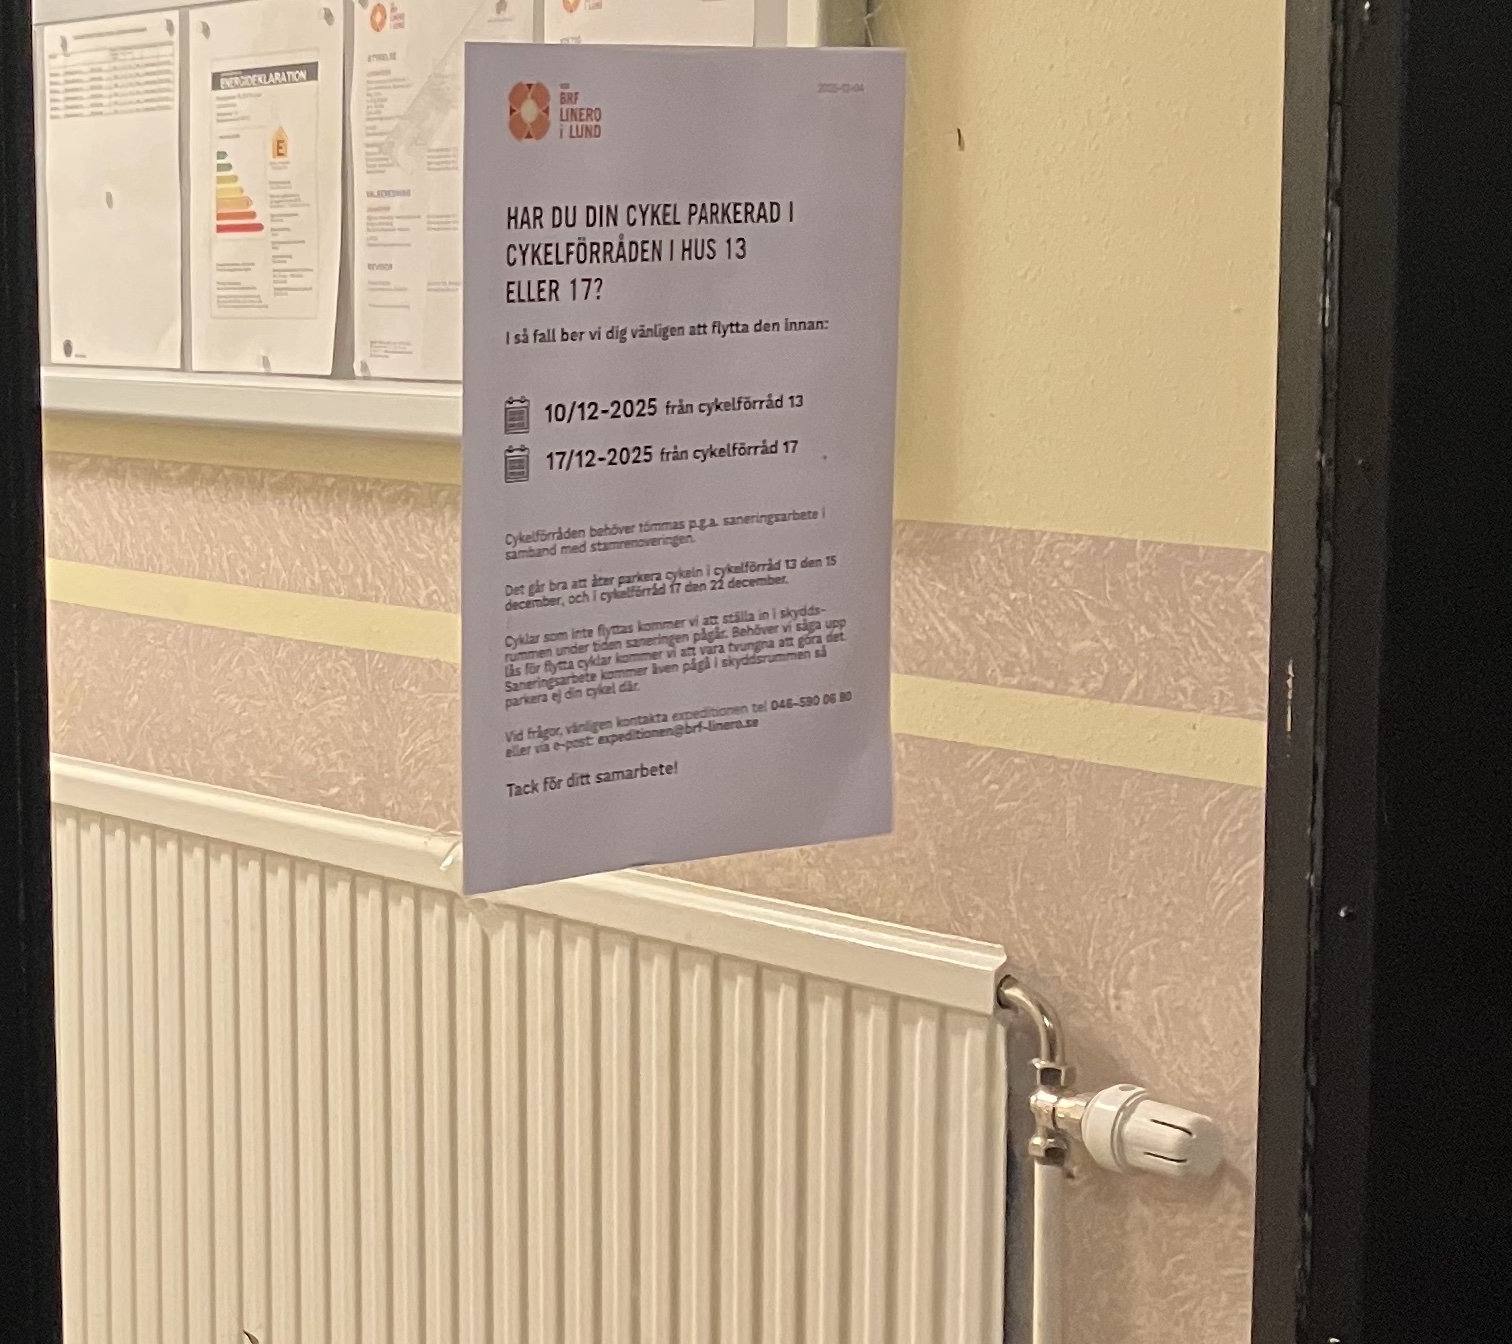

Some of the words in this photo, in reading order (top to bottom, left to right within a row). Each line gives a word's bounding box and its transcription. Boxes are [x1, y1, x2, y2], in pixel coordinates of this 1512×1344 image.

[219, 69, 307, 89] ENERGIDEKLARATION
[559, 91, 579, 105] BRF
[559, 107, 602, 123] LINERO
[569, 124, 602, 139] LUND
[276, 139, 285, 156] E
[507, 206, 543, 229] HAR
[551, 205, 577, 228] DU
[586, 204, 618, 227] DIN
[626, 202, 681, 226] CYKEL
[688, 201, 781, 225] PARKERAD
[788, 201, 794, 223] I
[506, 233, 662, 267] CYKELFÖRRÅDEN
[669, 240, 674, 261] I
[681, 239, 716, 261] HUS
[725, 237, 746, 260] 13
[506, 279, 560, 303] ELLER
[570, 277, 603, 301] 17?
[505, 332, 510, 344] I
[514, 328, 529, 344] så
[533, 328, 557, 343] fall
[560, 327, 585, 342] ber
[588, 326, 602, 340] vi
[606, 324, 628, 343] dig
[631, 322, 685, 341] vänligen
[689, 322, 708, 336] att
[711, 320, 750, 338] flytta
[754, 318, 780, 333] den
[784, 317, 829, 332] innan:
[544, 397, 658, 424] 10/12-2025
[665, 399, 694, 416] från
[698, 393, 784, 416] cykelförråd
[789, 395, 804, 408] 13
[546, 445, 653, 471] 17/12-2025
[660, 444, 689, 462] från
[693, 439, 778, 463] cykelförråd
[783, 440, 799, 454] 17
[505, 526, 585, 548] Cykelförråden
[589, 522, 636, 538] behöver
[638, 520, 685, 534] tömmas
[723, 509, 818, 526] saneringsarbete
[505, 545, 557, 561] samband
[560, 541, 586, 555] med
[505, 584, 526, 597] Det
[528, 580, 546, 597] går
[549, 578, 568, 592] bra
[571, 578, 588, 589] att
[618, 571, 662, 588] parkera
[665, 565, 703, 584] cykeln
[714, 558, 781, 581] cykelförråd
[785, 559, 797, 570] 13
[801, 556, 822, 569] den
[825, 555, 837, 567] 15
[568, 591, 590, 605] och
[600, 583, 666, 604] cykelförråd
[669, 582, 681, 594] 17
[685, 580, 706, 593] den
[710, 579, 725, 591] 22
[505, 633, 540, 650] Cyklar
[543, 631, 568, 642] som
[571, 626, 594, 640] inte
[598, 623, 634, 641] flyttas
[637, 617, 686, 633] kommer
[689, 614, 699, 627] vi
[702, 615, 719, 626] att
[758, 610, 769, 621] in
[556, 642, 589, 656] under
[593, 639, 622, 653] tiden
[626, 632, 689, 649] saneringen
[732, 624, 779, 638] Behöver
[782, 622, 792, 633] vi
[825, 618, 847, 633] upp
[505, 671, 597, 692] Saneringsarbete
[601, 666, 648, 681] kommer
[814, 645, 827, 658] så
[577, 655, 612, 672] cyklar
[615, 650, 663, 664] kommer
[666, 647, 677, 658] vi
[681, 647, 696, 658] att
[700, 644, 725, 656] vara
[728, 640, 775, 654] tvungna
[778, 637, 794, 648] att
[505, 692, 548, 710] parkera
[551, 690, 563, 704] ej
[564, 688, 583, 700] din
[586, 683, 616, 700] cykel
[505, 729, 523, 742] Vid
[566, 719, 613, 734] vänligen
[616, 712, 668, 728] kontakta
[752, 700, 768, 713] tel
[505, 744, 531, 758] eller
[535, 742, 550, 754] via
[507, 779, 539, 798] Tack
[543, 776, 564, 792] för
[567, 771, 591, 788] ditt
[595, 760, 678, 784] samarbete!
